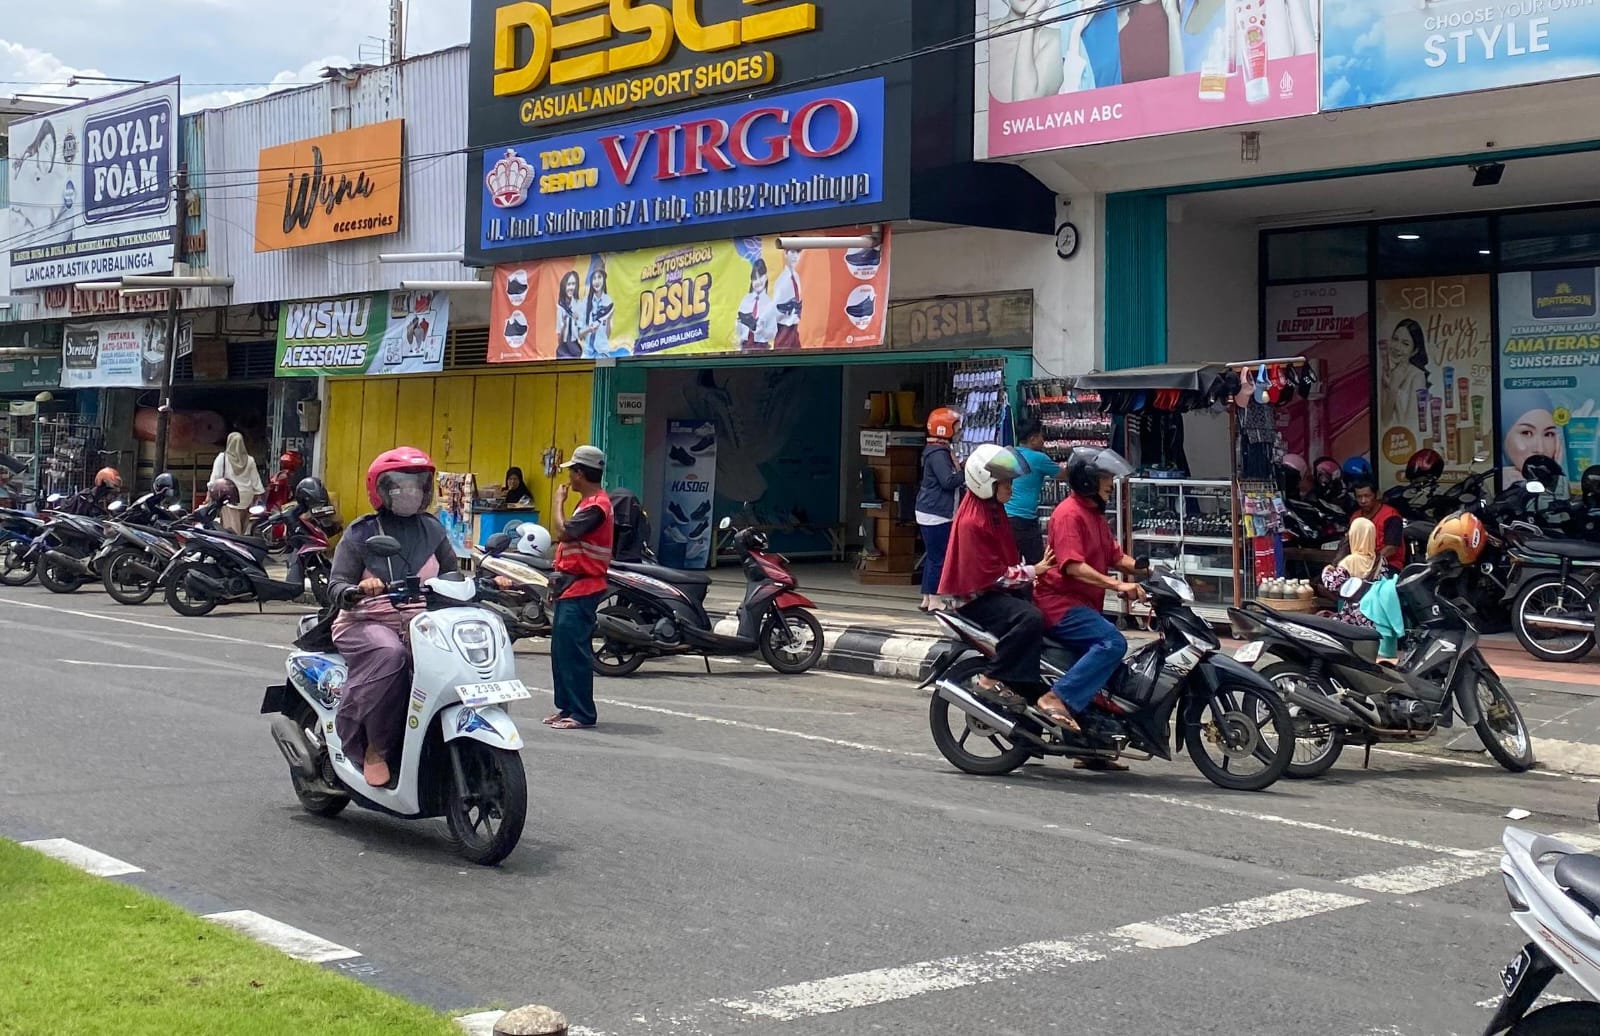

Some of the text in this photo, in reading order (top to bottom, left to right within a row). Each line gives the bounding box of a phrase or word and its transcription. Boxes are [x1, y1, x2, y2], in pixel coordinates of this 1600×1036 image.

[1424, 7, 1494, 32] CHOOSE
[1498, 0, 1543, 18] YOUR
[1424, 17, 1550, 68] STYLE
[521, 55, 763, 123] CASUAL AND SPORT SHOES
[1002, 103, 1123, 136] SWALAYAN ABC
[88, 113, 164, 163] ROYAL
[599, 97, 859, 185] VIRGO
[539, 146, 586, 170] TOKO
[94, 156, 159, 202] FOAM
[282, 146, 375, 234] Wisnu
[539, 168, 599, 194] SEPATU
[545, 207, 614, 234] Sudirman
[638, 198, 650, 224] A
[654, 194, 691, 224] Telp.
[759, 172, 870, 208] Purbalingga
[333, 213, 393, 233] accessories
[25, 252, 154, 282] LANCAR PLASTIK PURBALINGGA
[678, 246, 712, 268] SCHOOL
[639, 273, 710, 331] DESLE
[1400, 280, 1466, 310] salsa
[285, 295, 371, 340] WISNU
[909, 298, 991, 344] DESLE
[1315, 316, 1356, 332] LIPSTICK
[1511, 324, 1566, 335] KEMANAPUN
[1567, 322, 1594, 332] KAMU
[66, 337, 97, 360] Serenity
[641, 328, 703, 351] VIRGO PURBALINGGA
[280, 343, 367, 369] ACESSORIES
[619, 401, 642, 409] VIRGO
[671, 480, 710, 493] KASOGI
